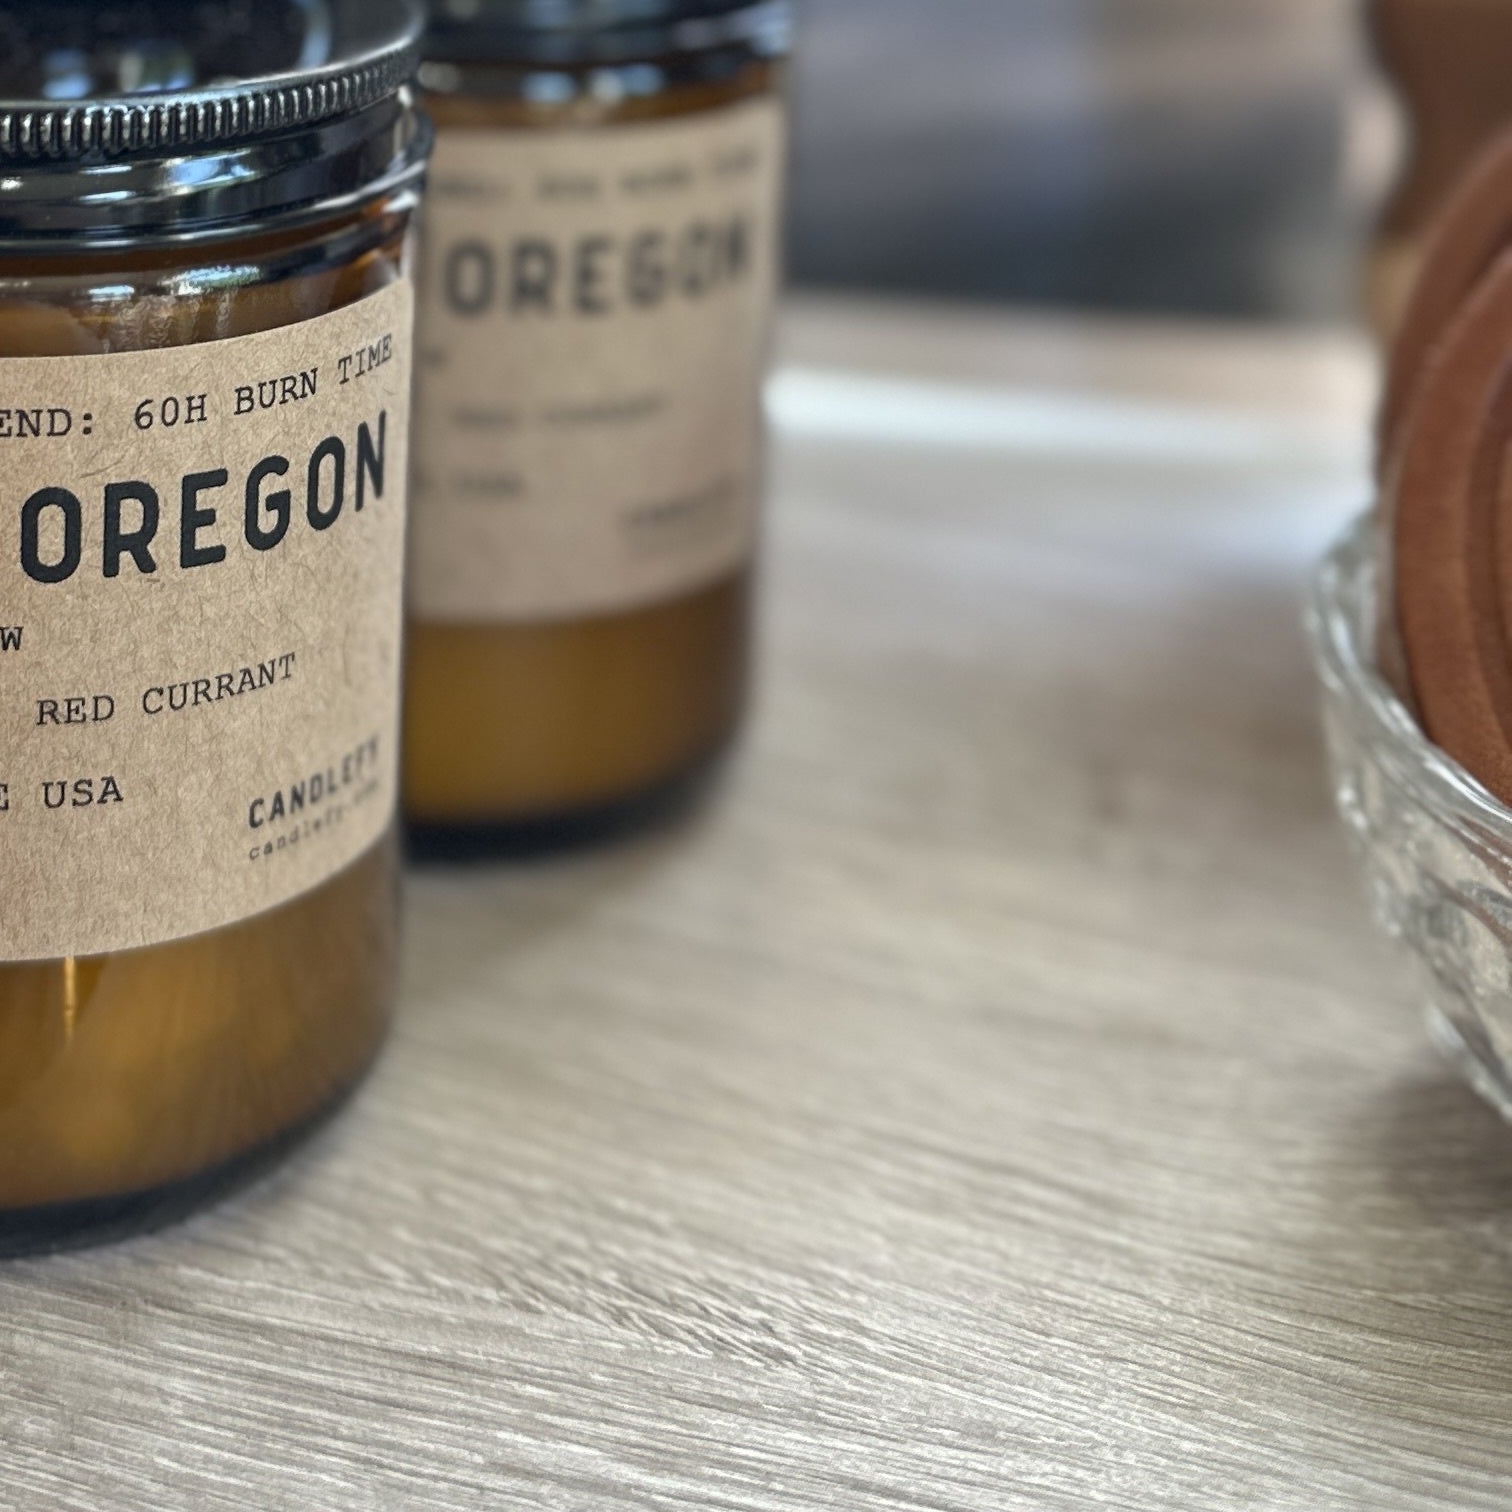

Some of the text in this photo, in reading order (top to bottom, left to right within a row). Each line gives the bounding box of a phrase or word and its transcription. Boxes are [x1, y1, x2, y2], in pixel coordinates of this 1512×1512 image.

[134, 393, 208, 430] 60H
[233, 366, 319, 416] BURN
[337, 333, 393, 386] TIME
[20, 408, 387, 584] OREGON
[0, 625, 25, 652] W
[35, 694, 116, 727] RED
[141, 651, 296, 715] CURRANT
[41, 775, 124, 809] USA
